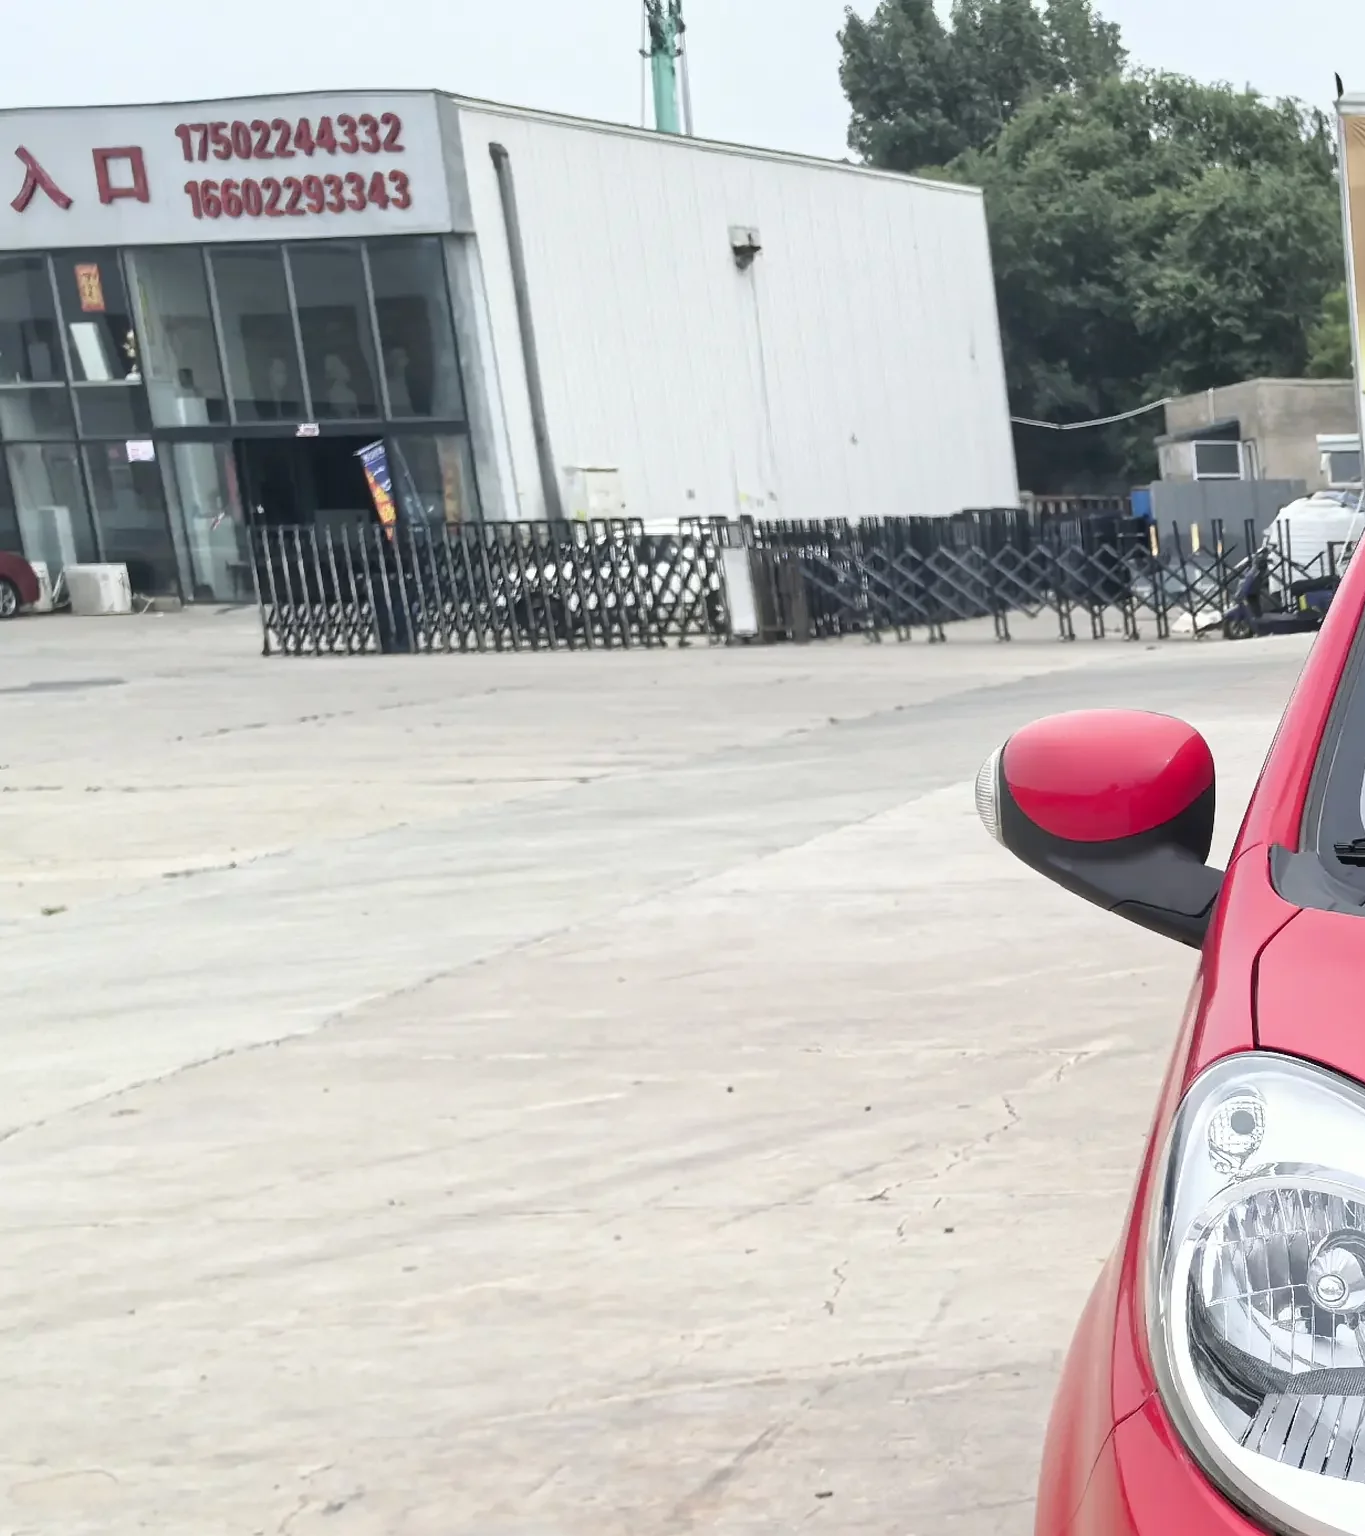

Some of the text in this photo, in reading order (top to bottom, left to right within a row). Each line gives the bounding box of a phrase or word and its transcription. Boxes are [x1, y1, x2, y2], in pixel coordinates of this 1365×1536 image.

[174, 112, 405, 163] 17502244332
[10, 144, 151, 213] 入口
[184, 169, 413, 219] 16602293343
